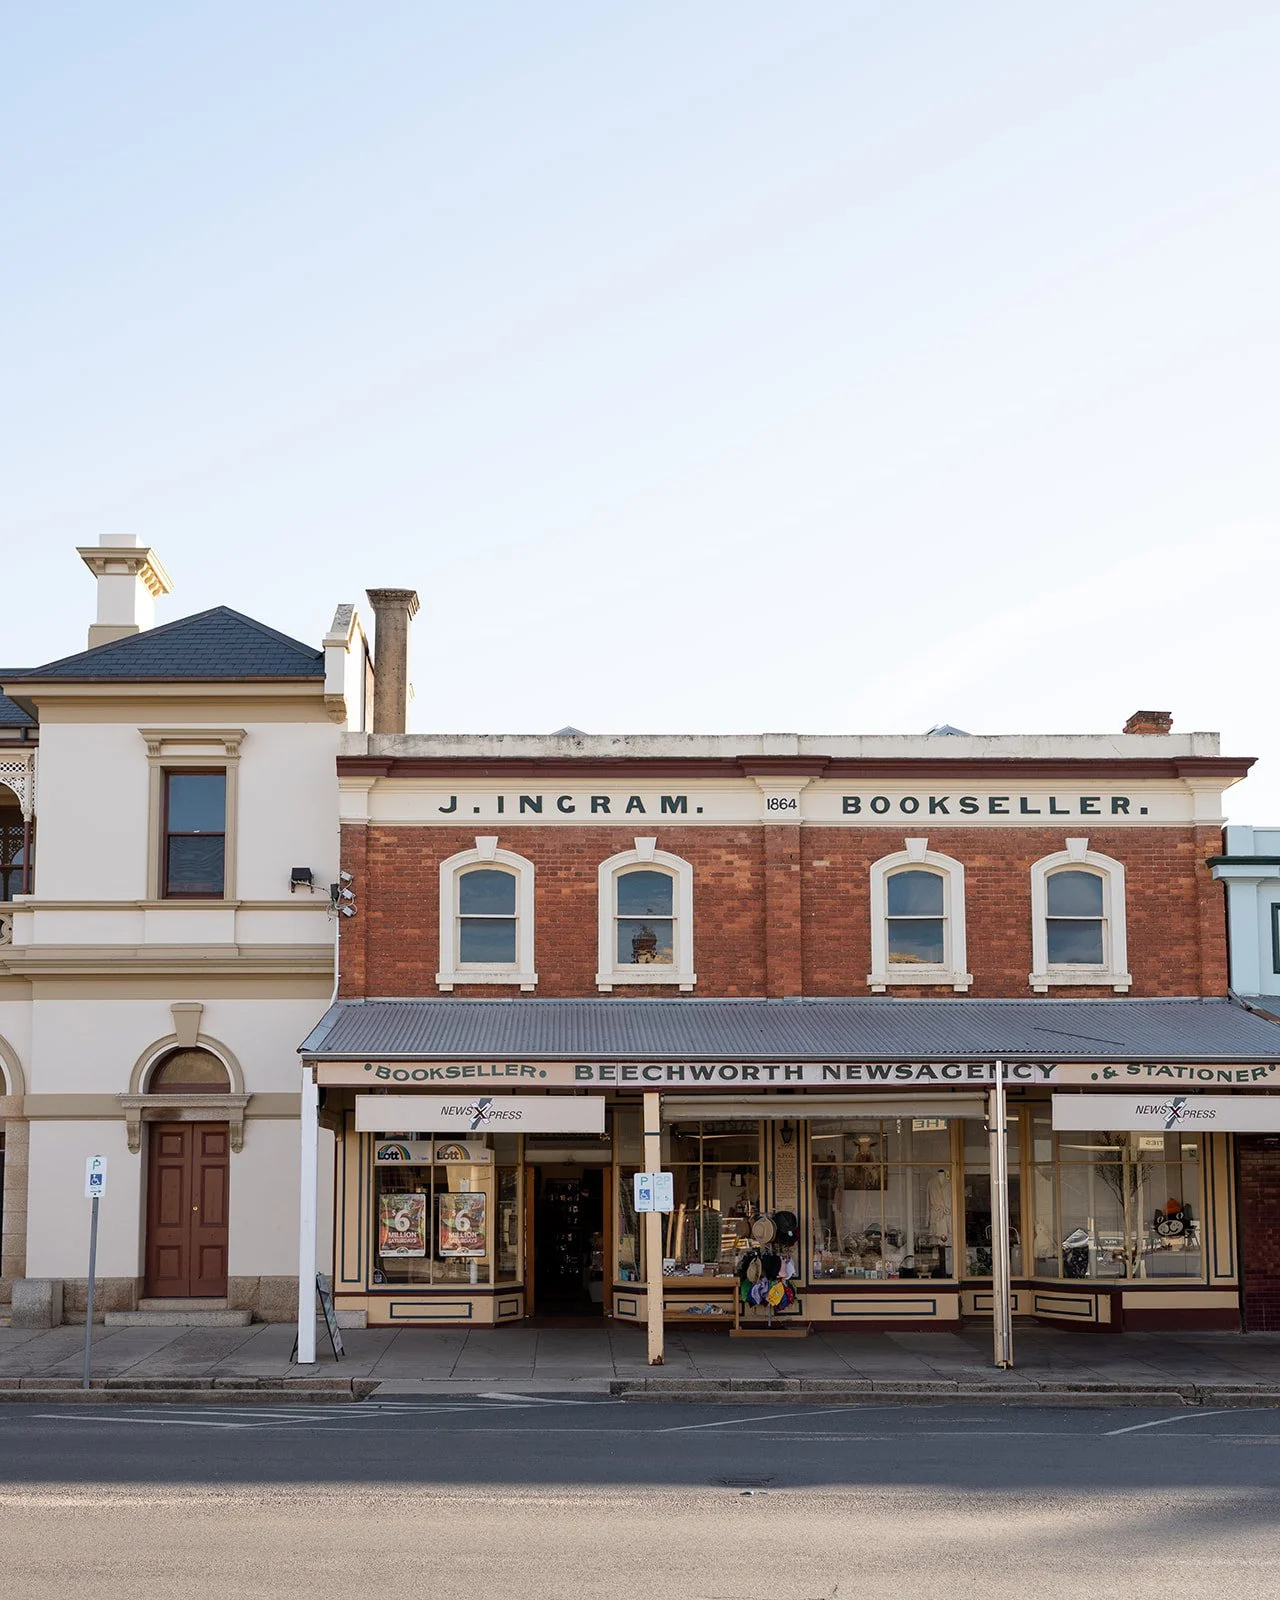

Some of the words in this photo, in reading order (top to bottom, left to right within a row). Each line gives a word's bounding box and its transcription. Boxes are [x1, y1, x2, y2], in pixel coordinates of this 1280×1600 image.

[766, 798, 798, 811] 1864
[842, 795, 1149, 815] BOOKSELLER.
[574, 1064, 804, 1081] BEECHWORTH
[822, 1064, 1058, 1080] NEWSAGENCY
[92, 1159, 102, 1170] P
[640, 1176, 649, 1186] P
[655, 1175, 672, 1186] 2P
